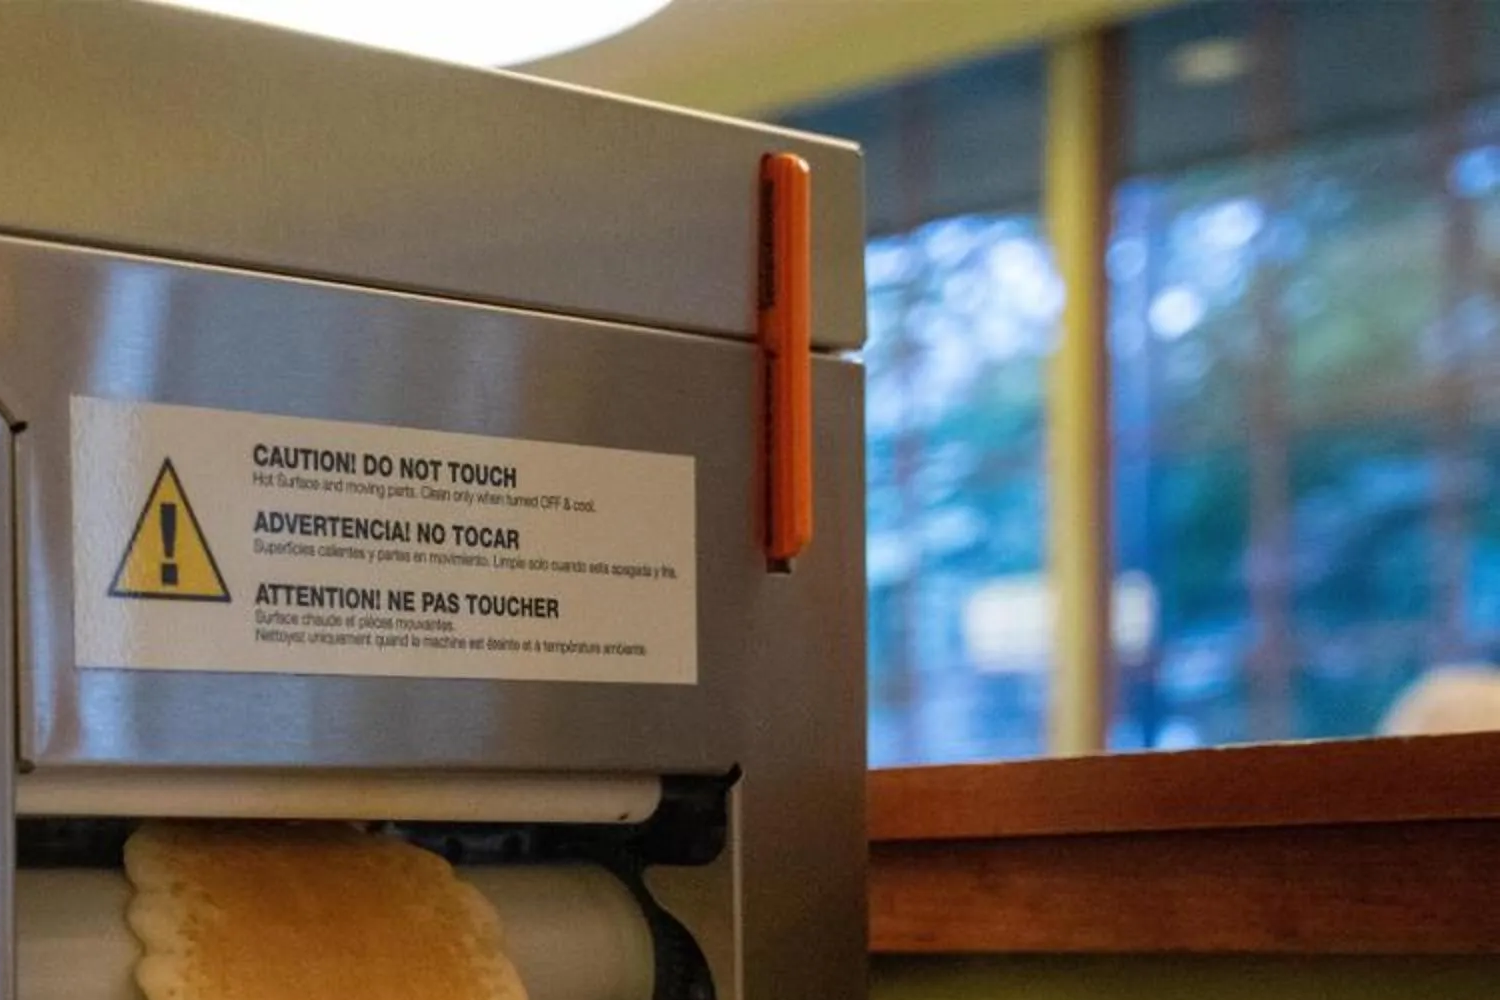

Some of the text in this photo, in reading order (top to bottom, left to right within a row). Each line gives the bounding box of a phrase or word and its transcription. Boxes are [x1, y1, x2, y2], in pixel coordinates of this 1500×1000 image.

[253, 444, 518, 488] CAUTION! DO NOT TOUCH
[253, 472, 274, 487] Hot
[276, 472, 320, 490] Surface
[322, 479, 343, 493] and
[345, 482, 386, 500] moving
[420, 485, 451, 502] Clean
[453, 490, 475, 507] only
[506, 493, 539, 508] turned
[540, 495, 562, 510] OFF
[563, 497, 571, 511] &
[254, 510, 520, 551] ADVERTENCIA! NO TOCAR
[254, 537, 316, 557] Superficies
[317, 545, 366, 560] calientes
[377, 549, 410, 564] partes
[413, 551, 428, 565] en
[255, 582, 560, 619] ATTENTION! NE PAS TOUCHER
[375, 633, 408, 651] quand
